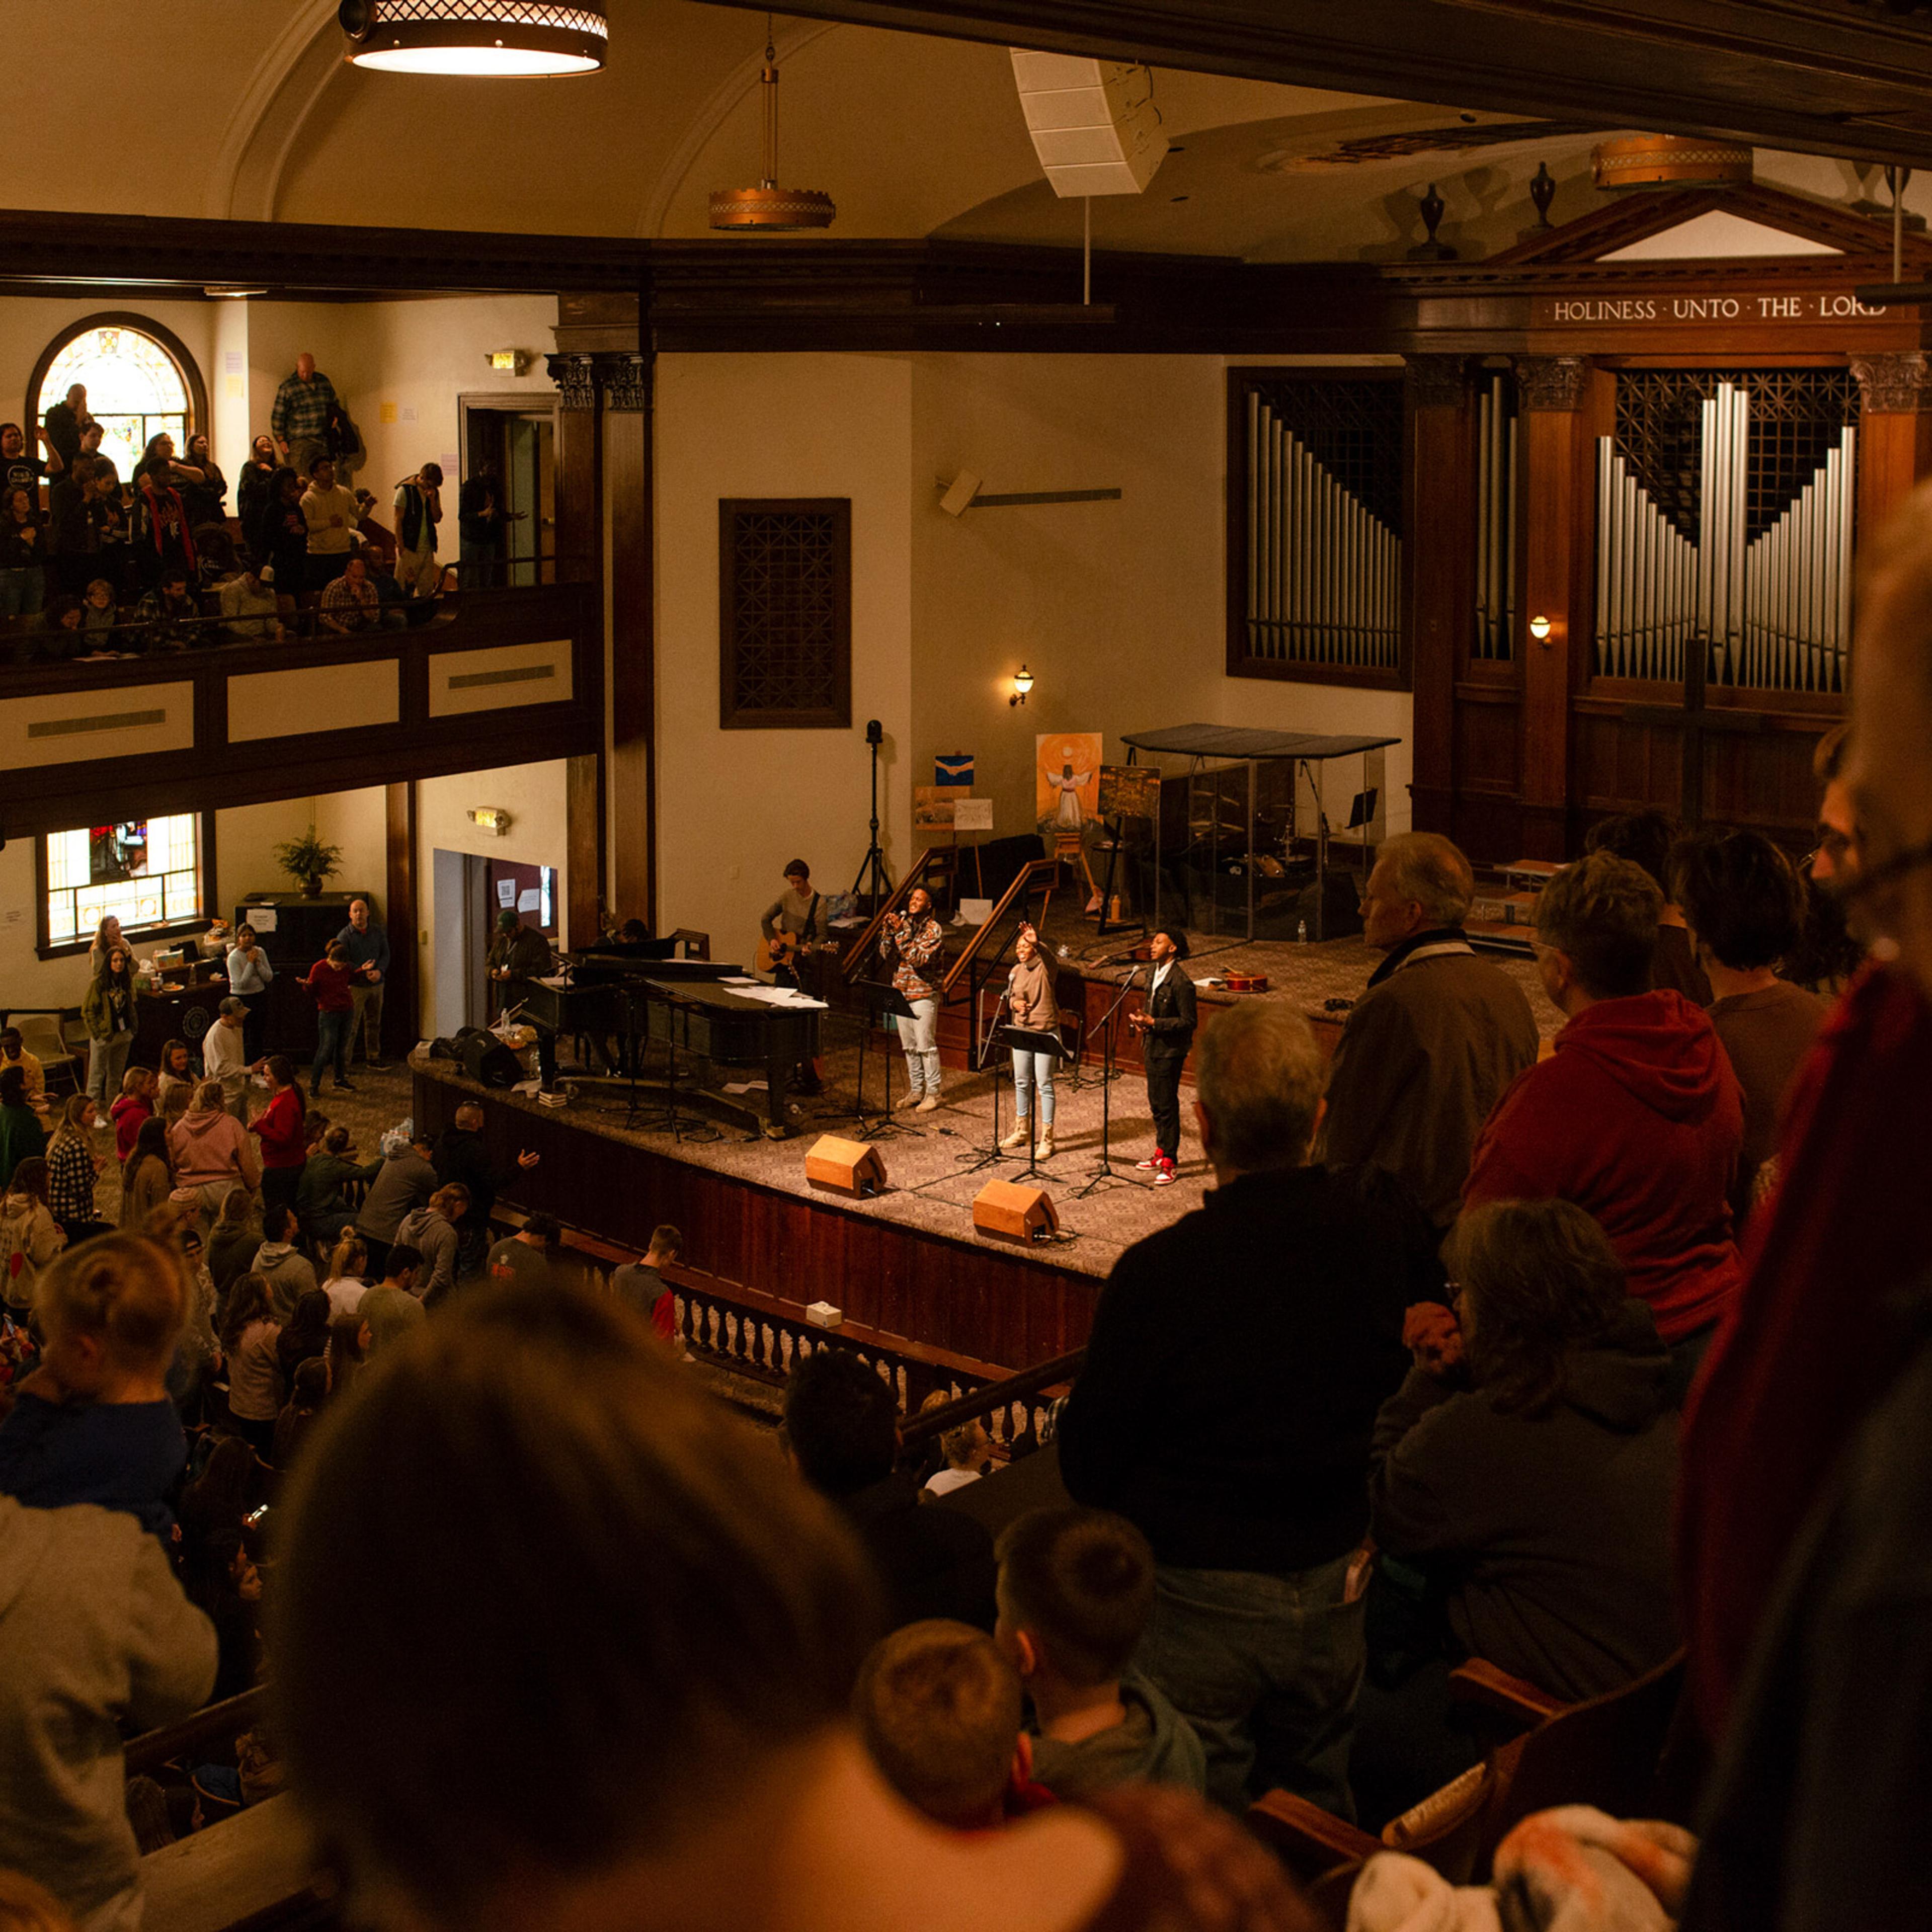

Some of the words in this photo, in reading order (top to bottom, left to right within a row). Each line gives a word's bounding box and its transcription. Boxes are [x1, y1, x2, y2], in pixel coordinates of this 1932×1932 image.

[1555, 300, 1656, 320] HOLINESS
[1673, 298, 1739, 318] UNTO
[1757, 297, 1802, 317] THE
